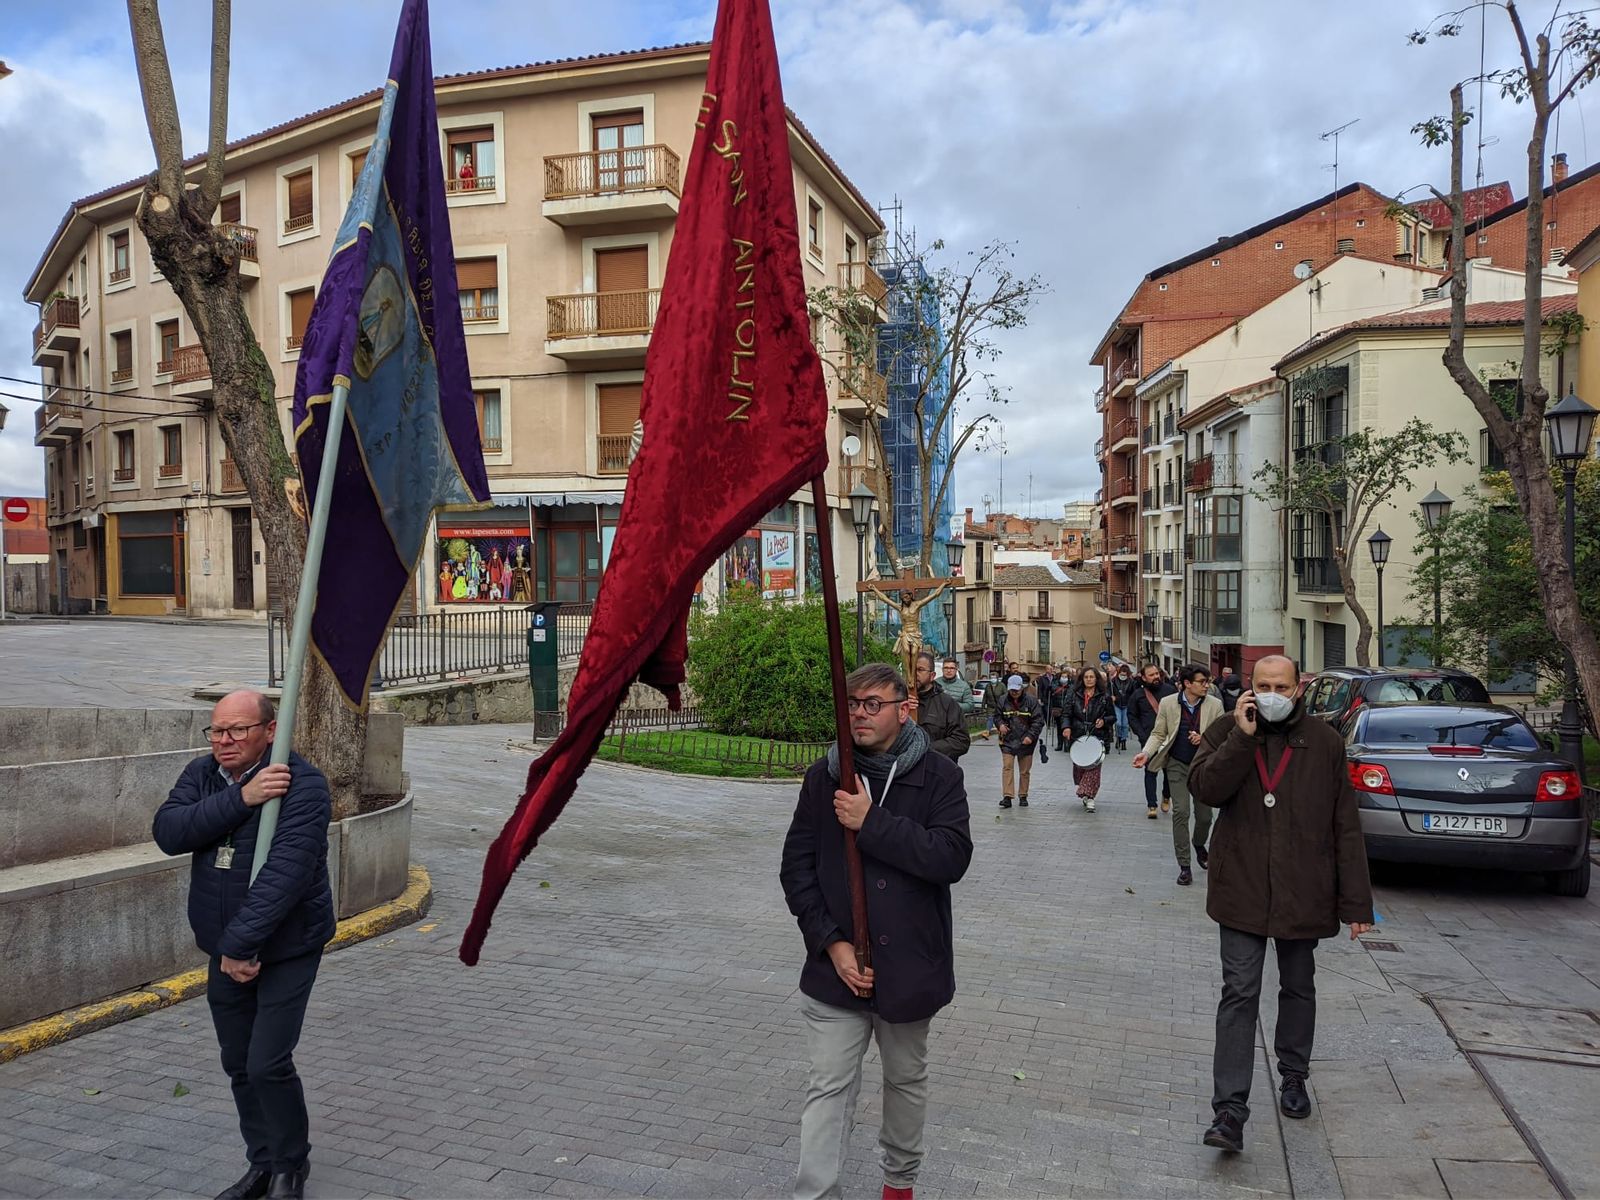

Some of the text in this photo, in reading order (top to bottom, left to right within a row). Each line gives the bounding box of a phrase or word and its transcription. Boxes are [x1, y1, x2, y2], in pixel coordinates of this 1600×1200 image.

[726, 239, 755, 420] ANTOLIN
[453, 528, 514, 536] www.lapeseta.com
[536, 614, 544, 626] P
[1432, 815, 1503, 831] 2127 FDR
